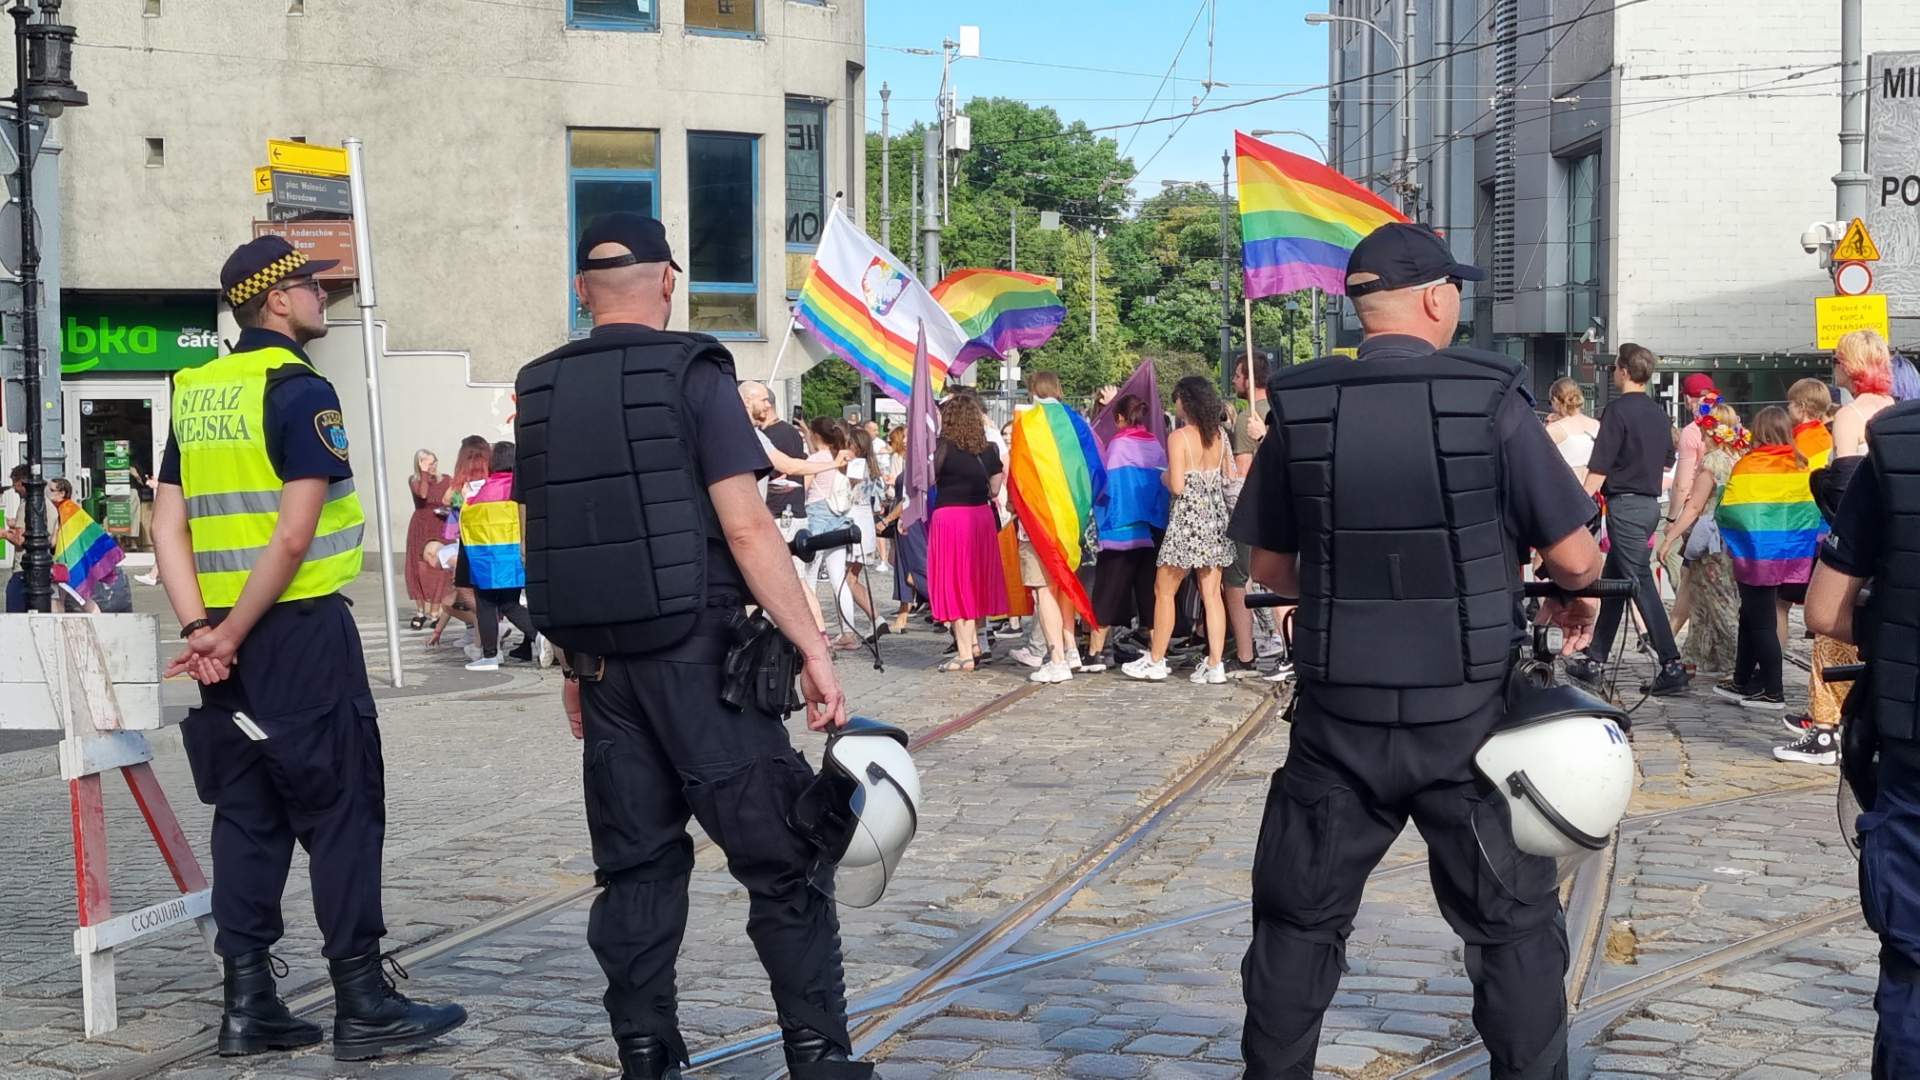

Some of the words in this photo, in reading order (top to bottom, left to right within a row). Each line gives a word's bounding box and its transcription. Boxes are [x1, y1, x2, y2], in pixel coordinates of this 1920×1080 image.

[1883, 66, 1920, 98] MI
[1881, 175, 1920, 207] PO
[60, 316, 157, 355] bka
